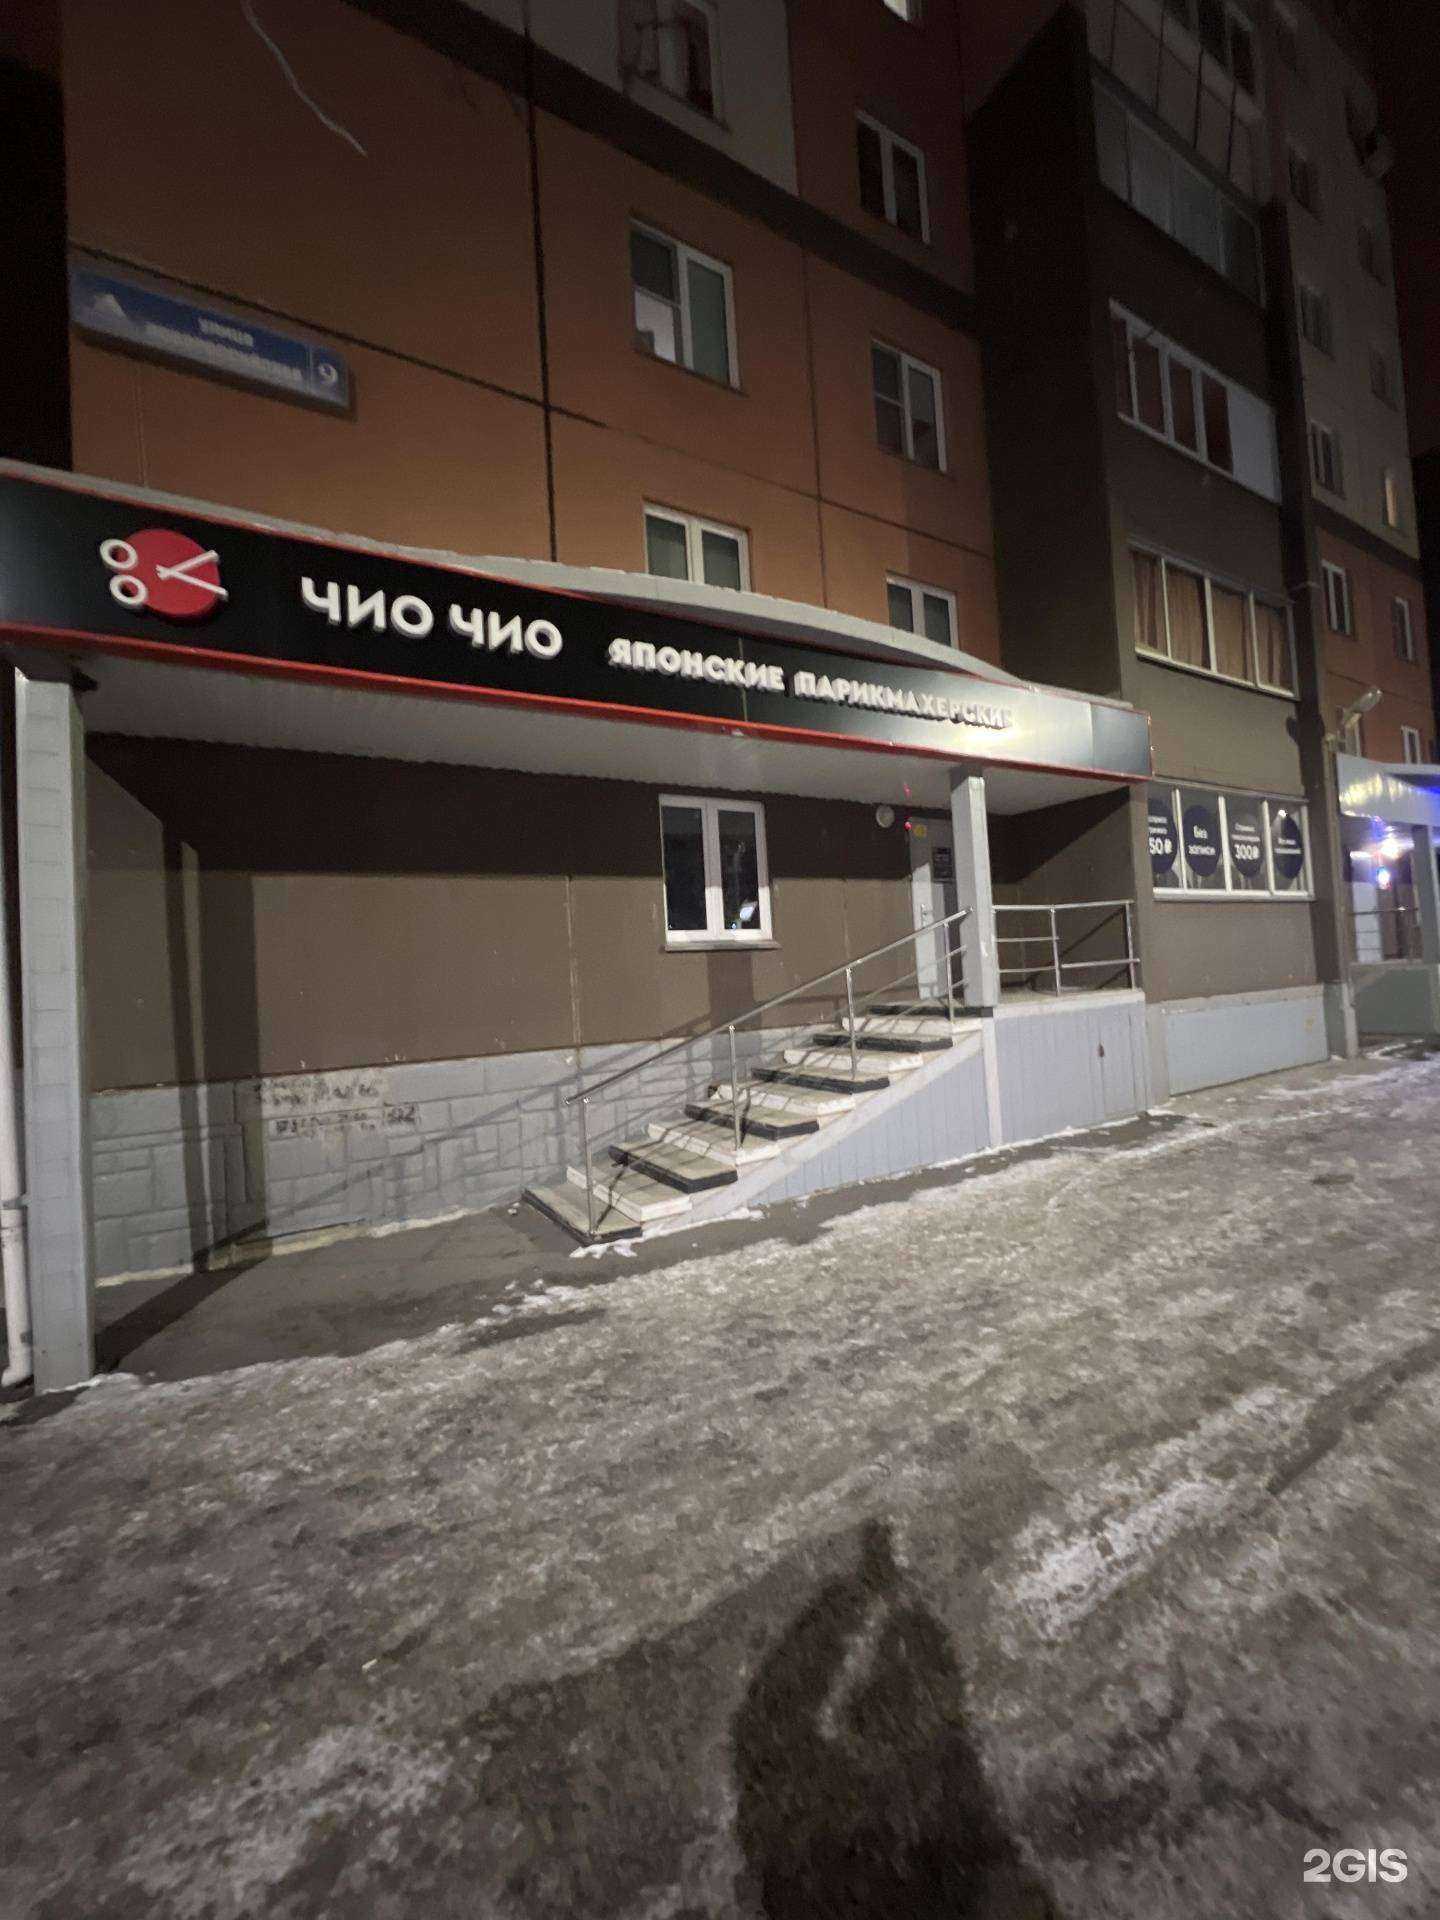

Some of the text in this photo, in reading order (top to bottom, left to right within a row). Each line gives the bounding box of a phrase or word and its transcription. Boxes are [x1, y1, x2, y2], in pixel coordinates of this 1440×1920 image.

[301, 576, 563, 660] ЧИО ЧИО
[608, 638, 1014, 729] ЯПОНСКИЕ ПАРИКМАХЕРСКИЕ
